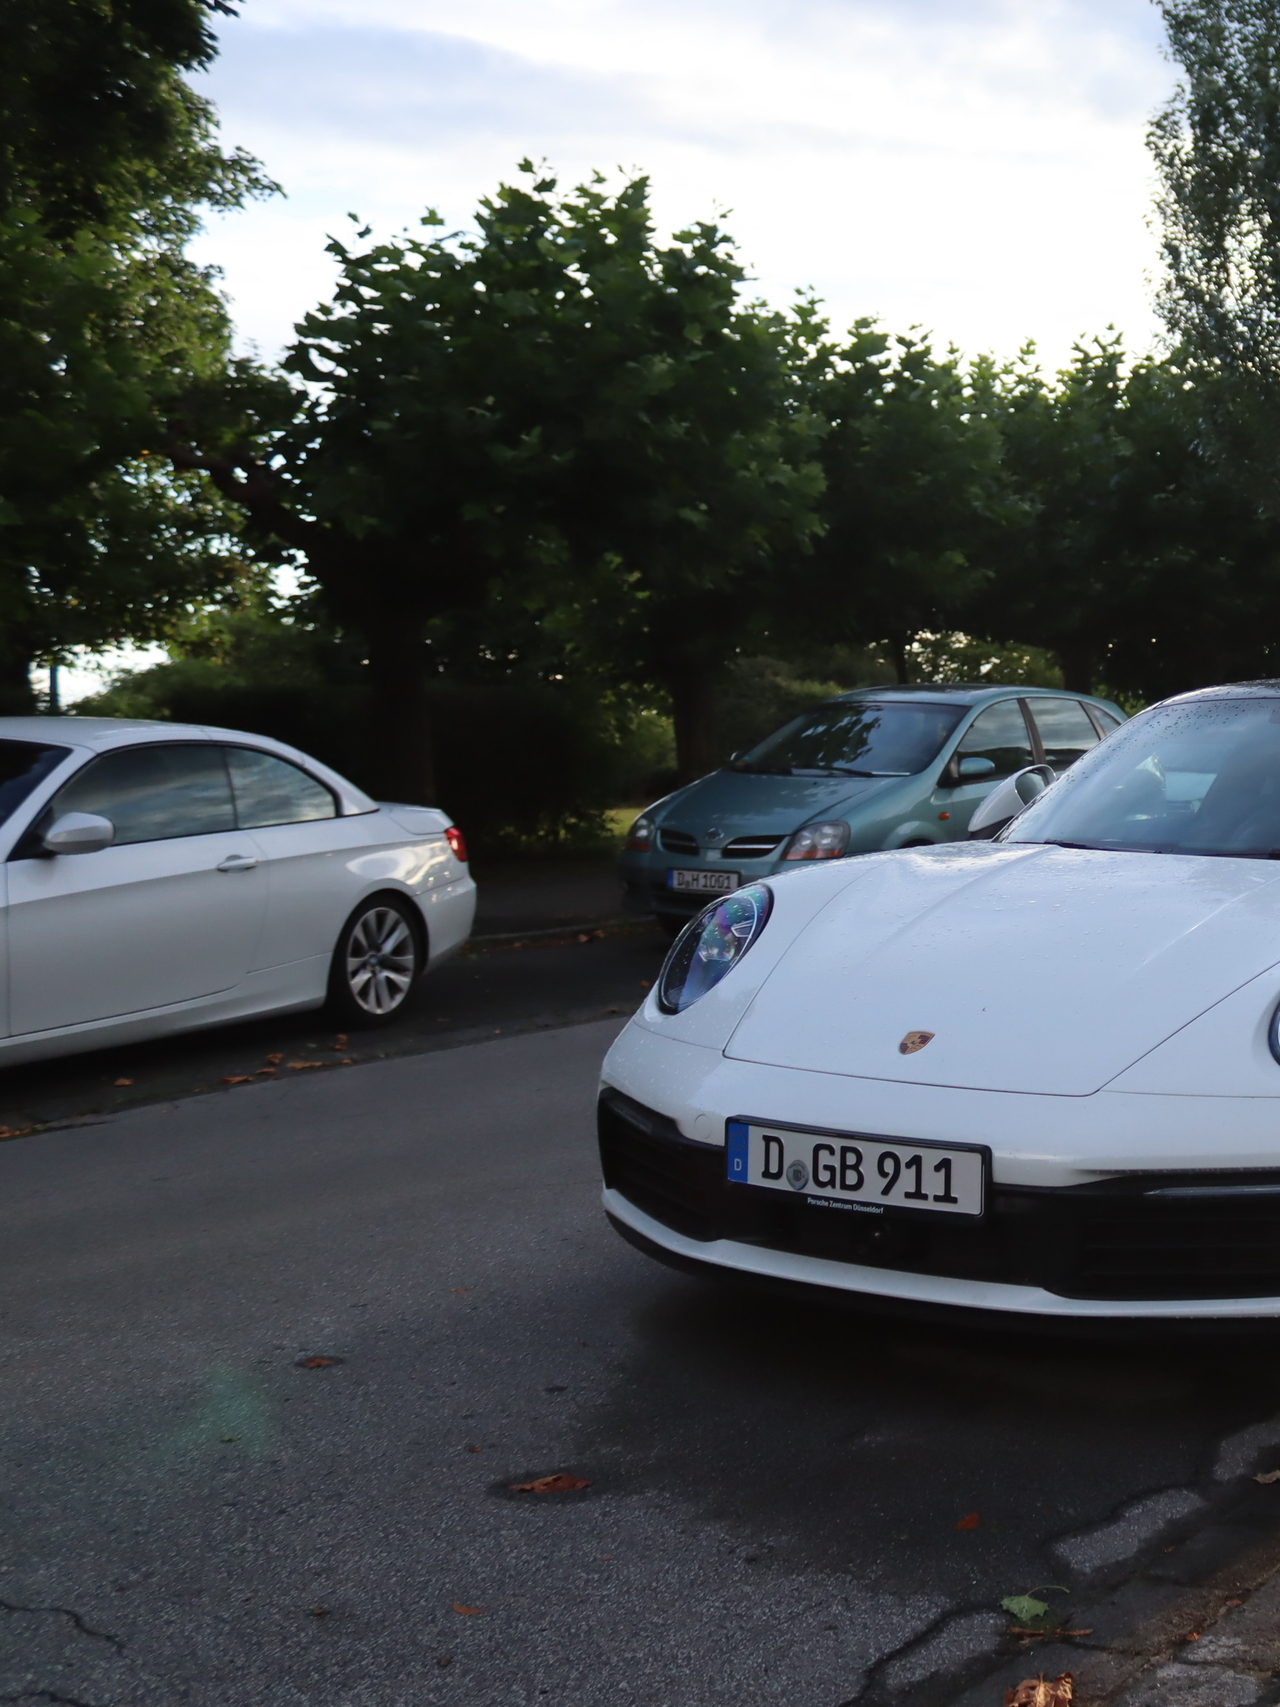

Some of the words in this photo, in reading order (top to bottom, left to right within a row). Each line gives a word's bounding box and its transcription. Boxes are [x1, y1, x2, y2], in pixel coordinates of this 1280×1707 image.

[677, 872, 685, 886] D
[734, 1158, 742, 1171] D
[761, 1134, 784, 1180] D
[812, 1142, 865, 1192] GB
[877, 1151, 958, 1204] 911
[807, 1197, 829, 1207] Porsche
[829, 1200, 852, 1210] Zentrum
[853, 1204, 884, 1214] Düsseldorf
